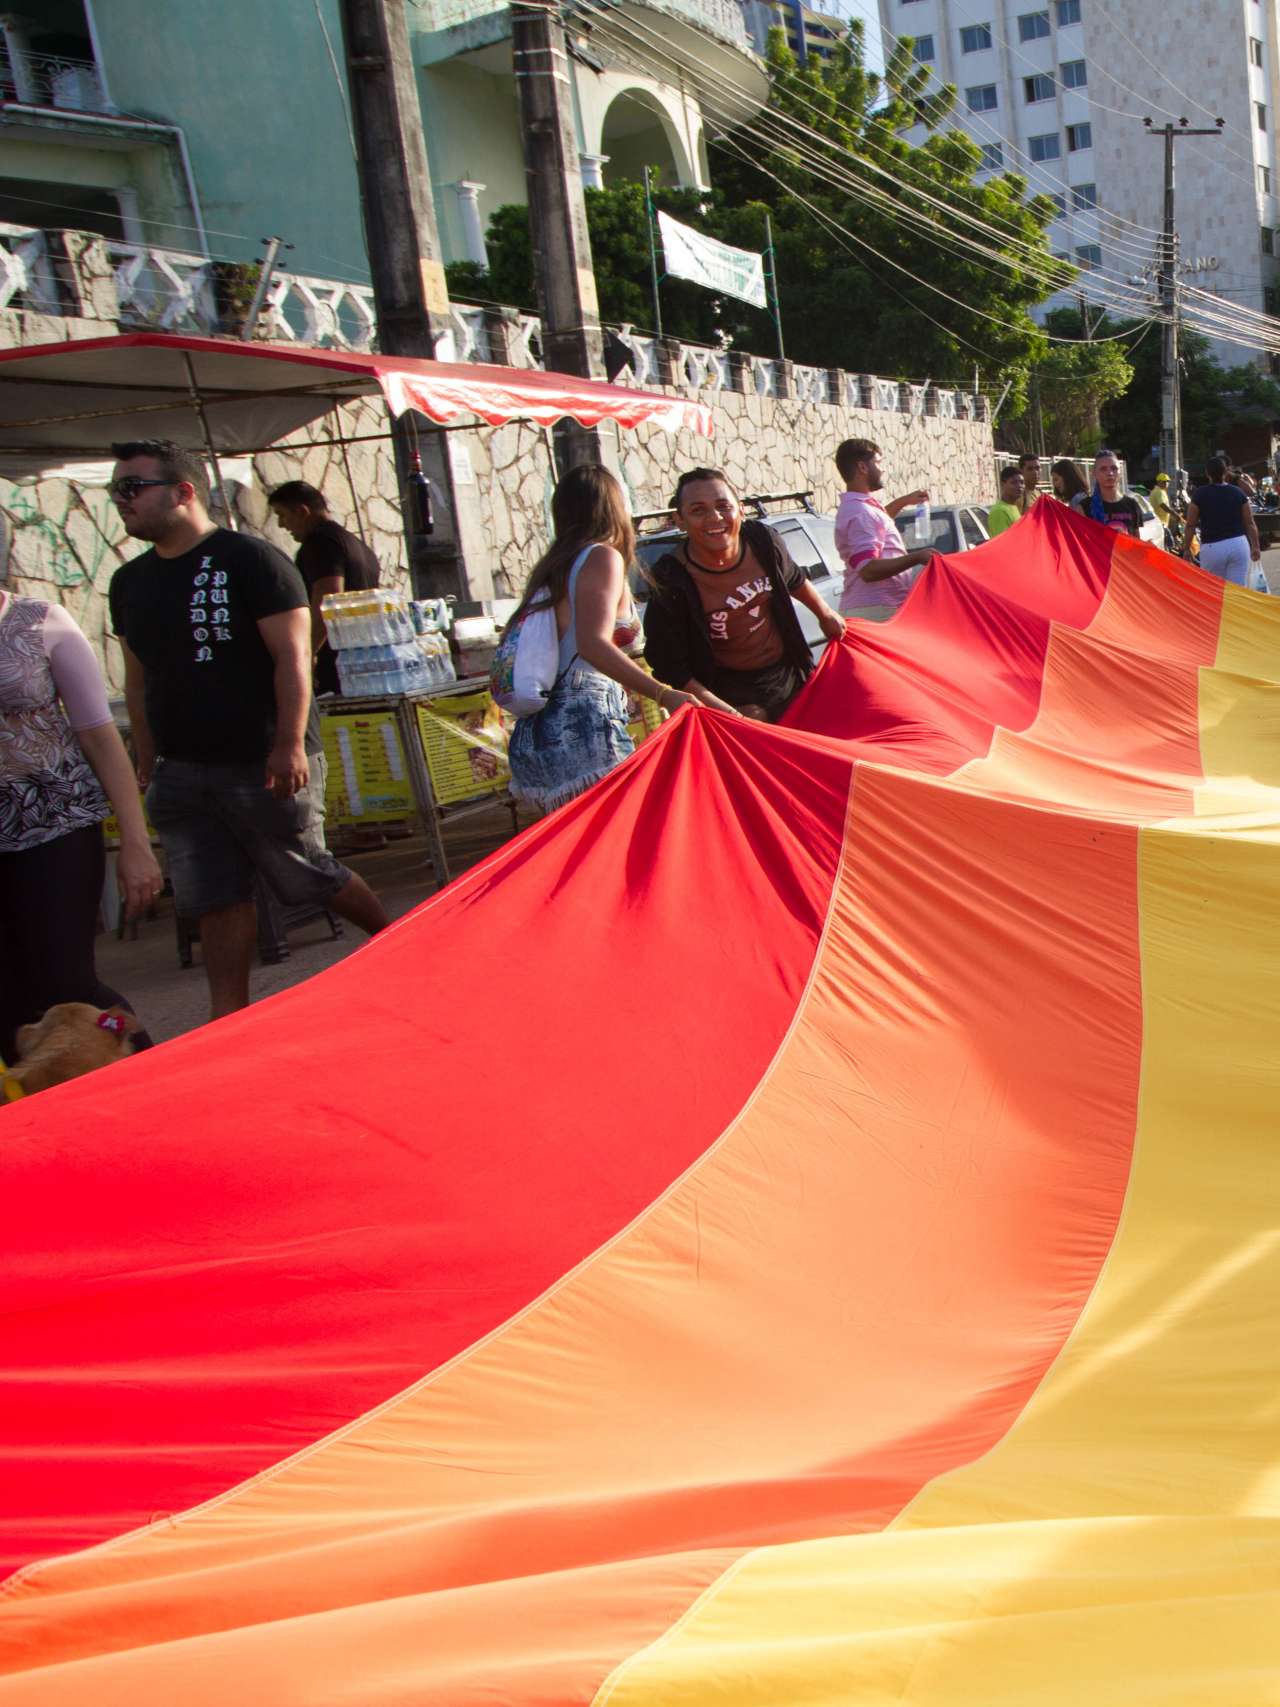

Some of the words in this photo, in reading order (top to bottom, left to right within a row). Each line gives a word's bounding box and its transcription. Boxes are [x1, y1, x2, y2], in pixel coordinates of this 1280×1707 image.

[190, 556, 213, 662] LONDON
[210, 570, 232, 641] PUNK
[710, 611, 729, 640] LOS
